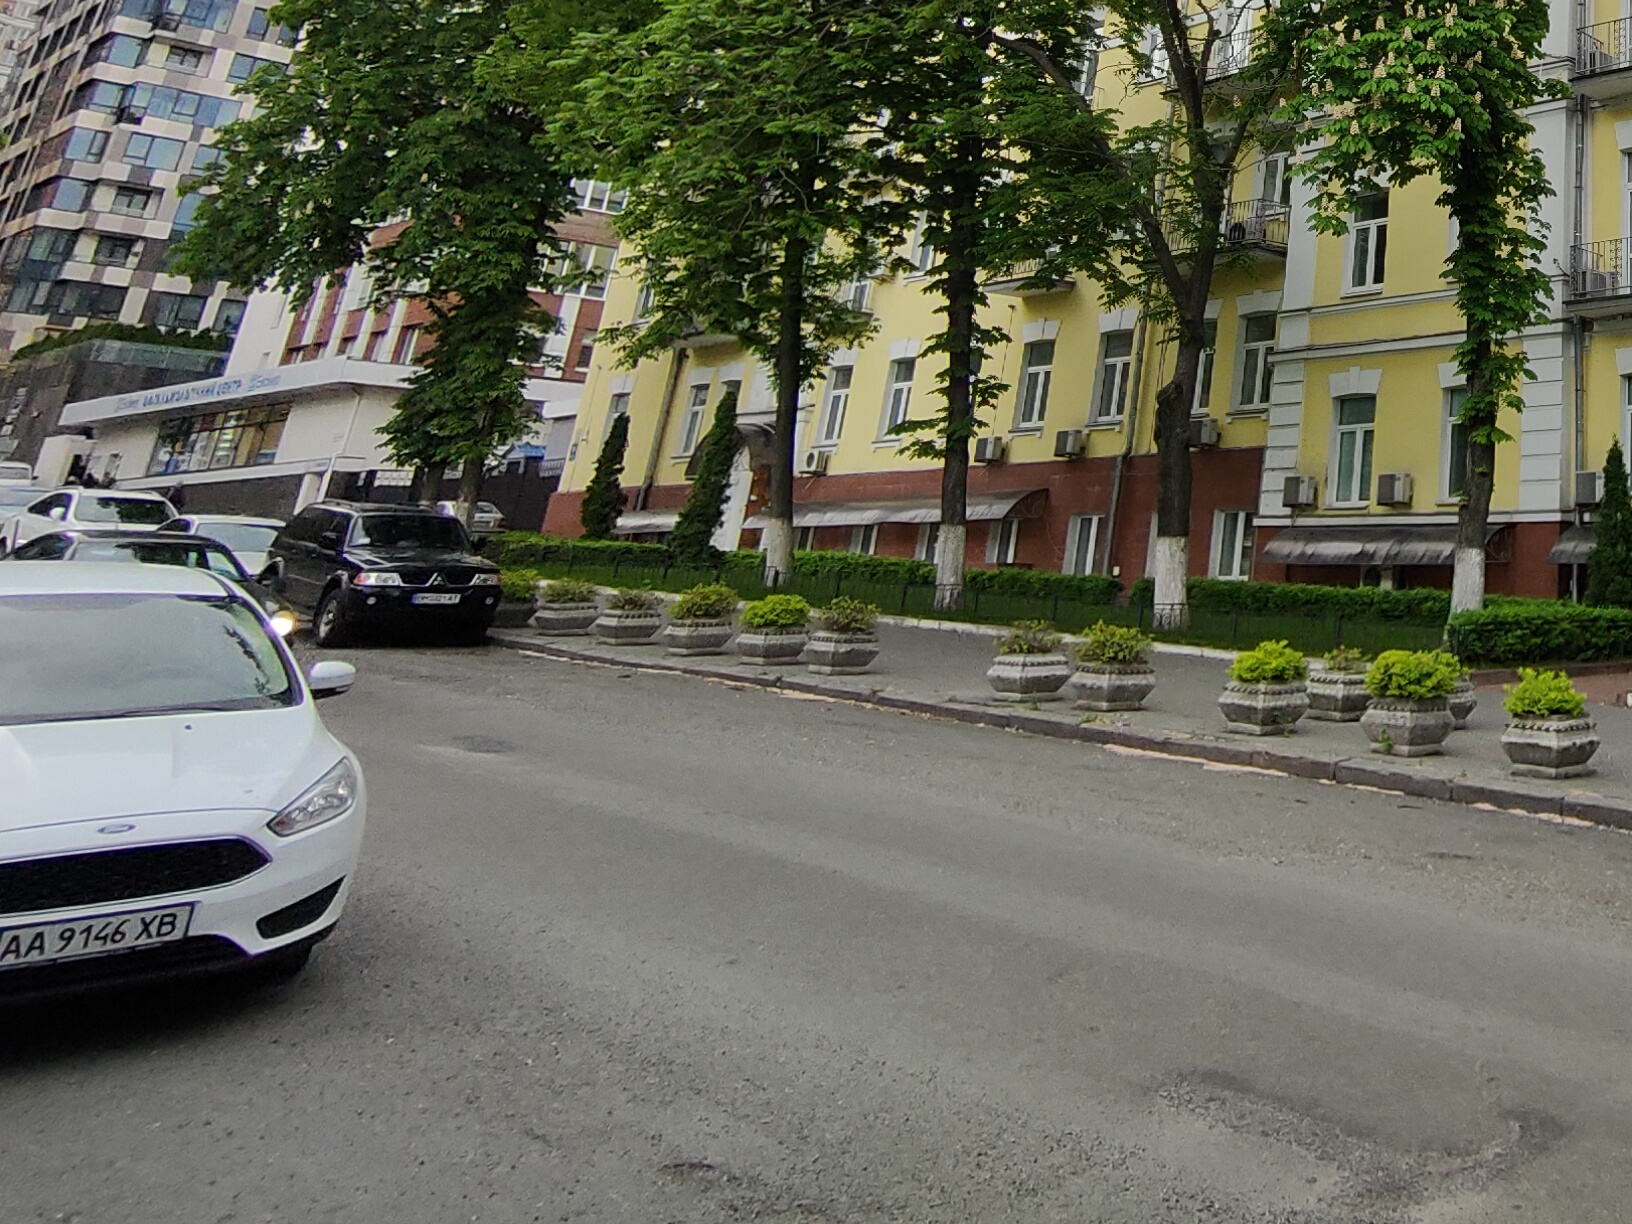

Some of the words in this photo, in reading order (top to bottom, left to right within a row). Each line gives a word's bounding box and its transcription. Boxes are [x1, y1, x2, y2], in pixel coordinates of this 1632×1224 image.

[1, 930, 46, 961] AA
[55, 919, 131, 954] 9146
[134, 912, 178, 942] XB
